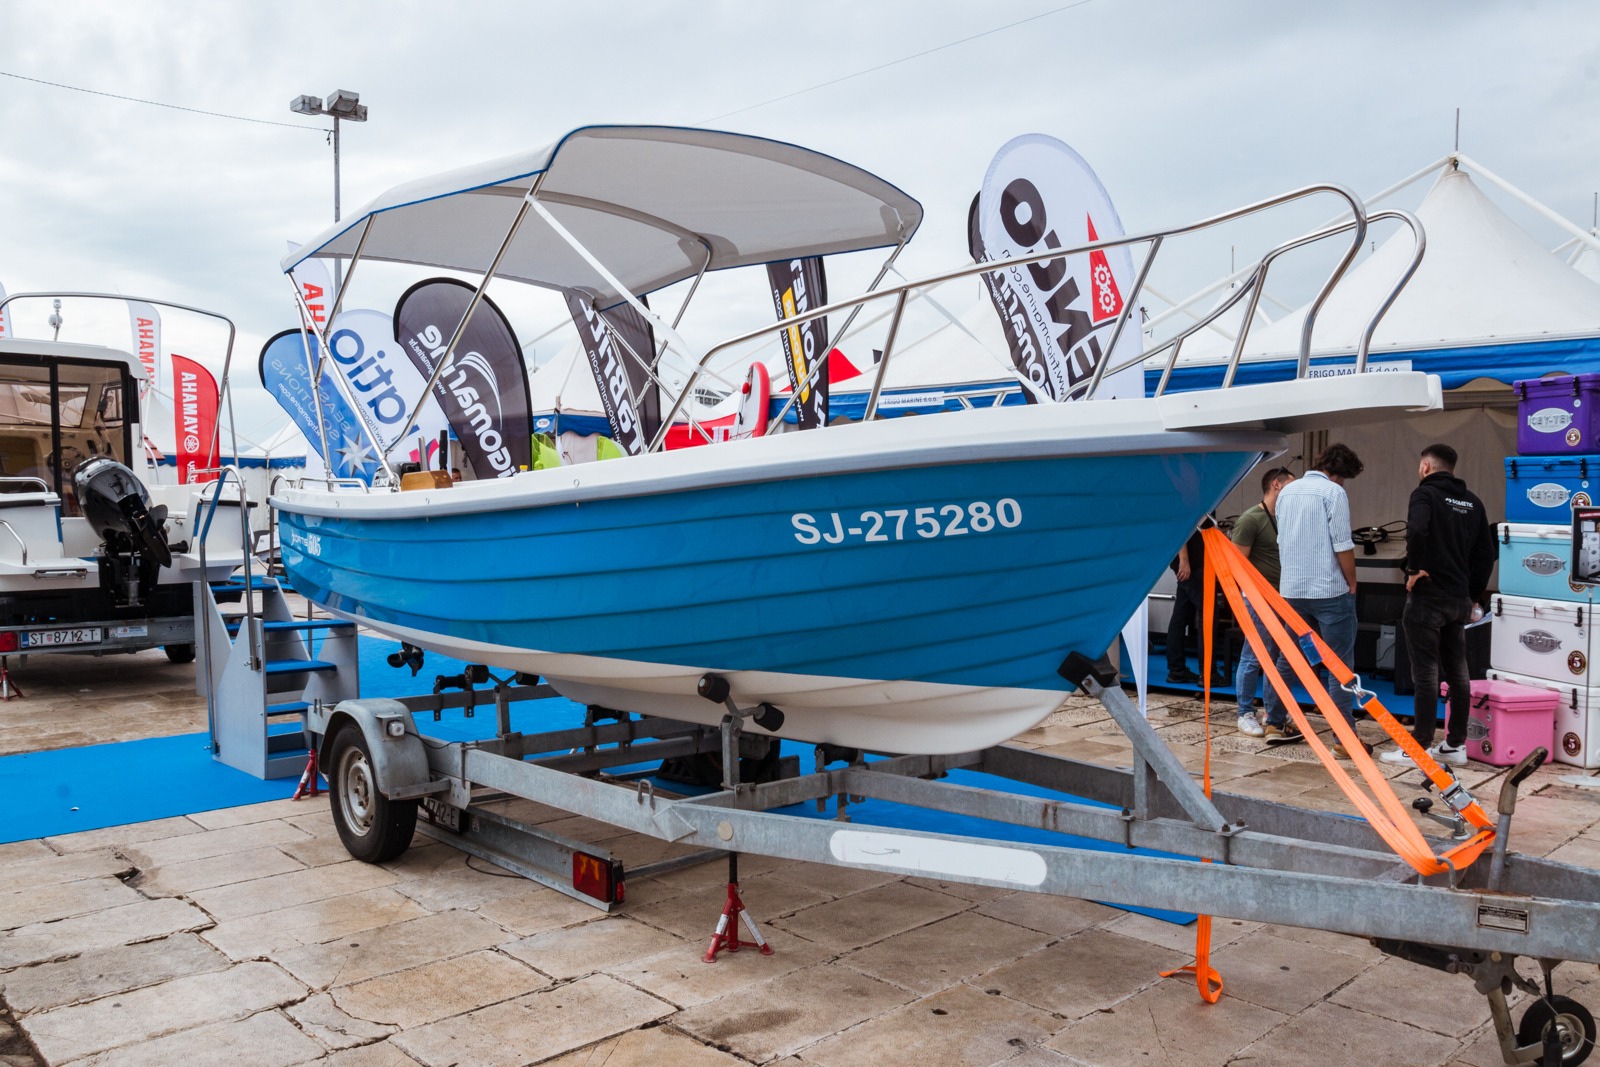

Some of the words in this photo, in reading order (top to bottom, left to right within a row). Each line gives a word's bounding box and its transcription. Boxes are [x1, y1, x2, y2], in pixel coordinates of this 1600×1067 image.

[791, 498, 1023, 544] SJ-275280
[30, 632, 46, 645] ST
[1573, 656, 1581, 668] 5
[1568, 738, 1576, 749] 5
